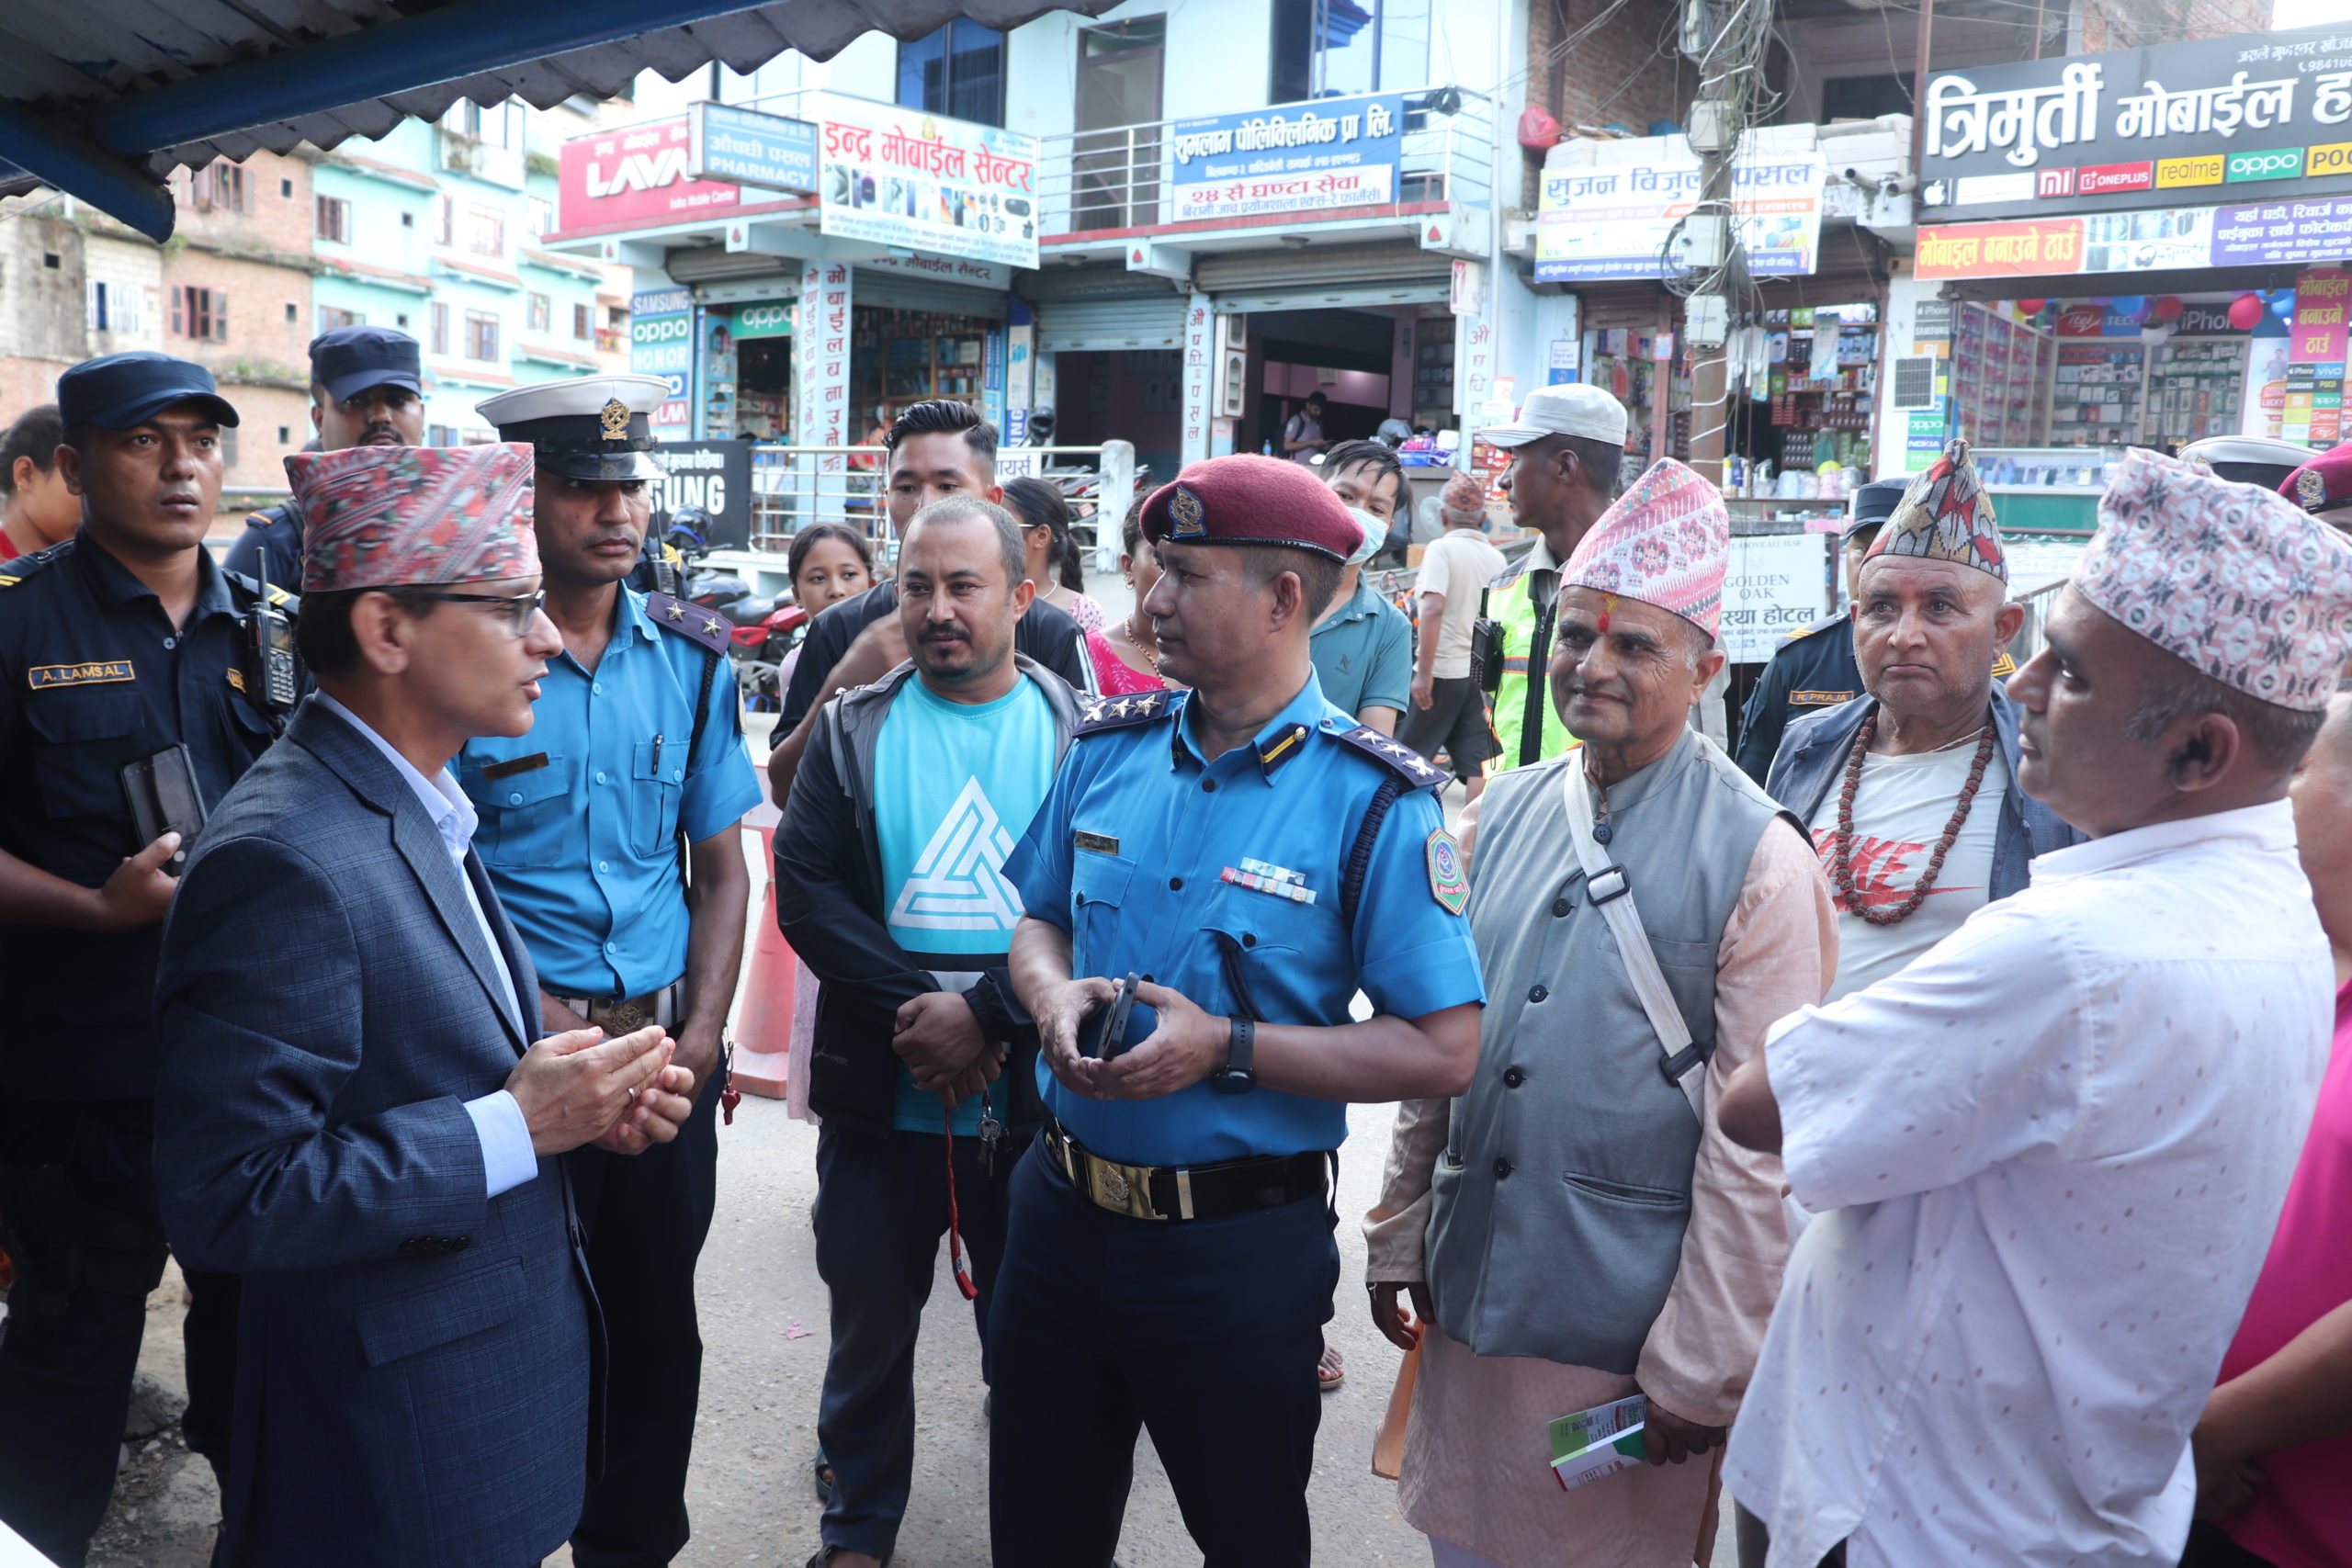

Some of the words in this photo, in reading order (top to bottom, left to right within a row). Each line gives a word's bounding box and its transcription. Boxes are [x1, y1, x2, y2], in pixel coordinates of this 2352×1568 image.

[2116, 71, 2300, 138] मोबाईल
[1236, 111, 1338, 151] पोलिक्लिनिक
[824, 120, 873, 164] इन्द्र
[880, 124, 966, 179] मोबाईल
[974, 143, 1033, 193] सेन्टर
[586, 147, 695, 197] LAVA
[708, 156, 812, 187] PHARMACY
[2098, 171, 2149, 186] ONEPLUS
[2161, 159, 2221, 181] realme
[1192, 188, 1219, 203] २४
[1250, 179, 1309, 198] घण्टा
[1315, 174, 1361, 193] सेवा
[1546, 175, 1621, 207] सुजन
[1732, 164, 1815, 186] पसल
[1919, 233, 1979, 267] मोबाइल
[1984, 226, 2039, 264] बनाउने
[2046, 219, 2078, 262] ठाउँ
[2298, 274, 2349, 299] मोबाईल
[633, 290, 689, 315] SAMSUNG
[2299, 301, 2344, 325] बनाउने
[633, 346, 687, 371] HONOR
[1908, 438, 1940, 448] NOKIA
[1724, 574, 1790, 588] GOLDEN
[1739, 588, 1775, 600] OAK
[1762, 604, 1816, 625] होटल
[41, 670, 58, 682] A.
[61, 664, 124, 681] LAMSAL
[1809, 694, 1847, 702] PRAJA
